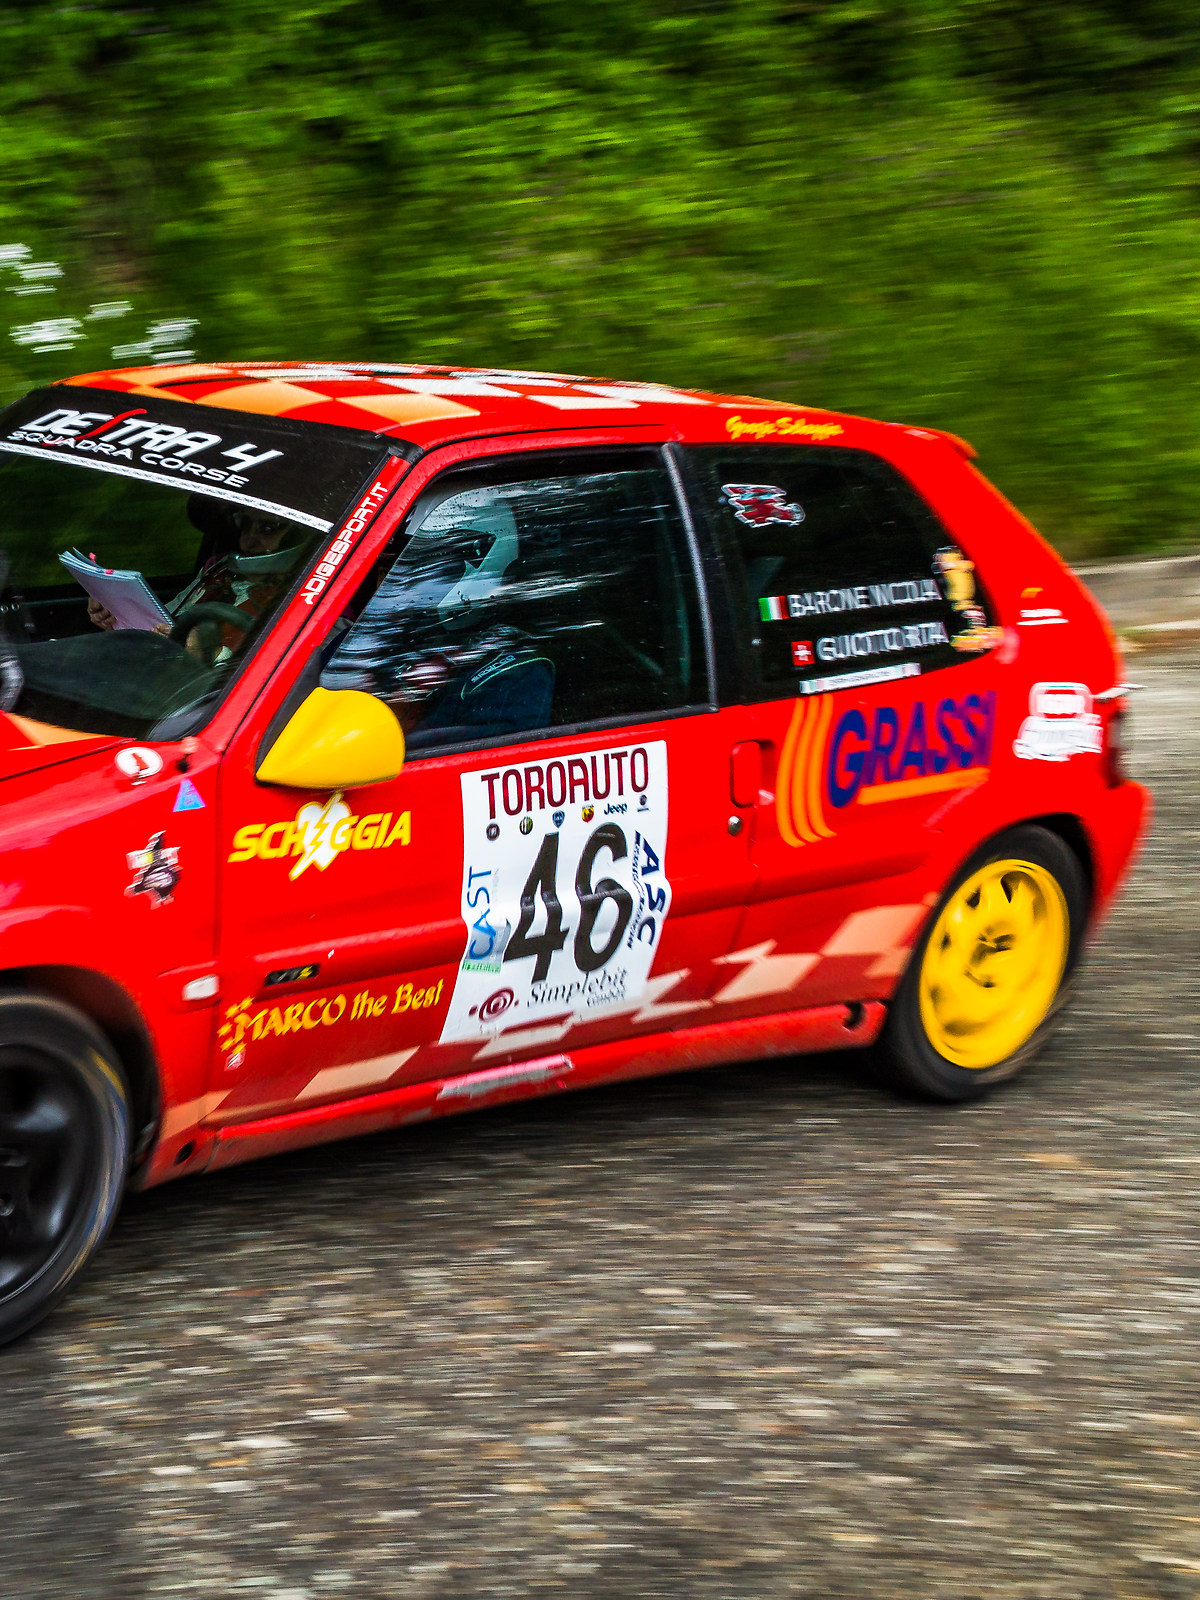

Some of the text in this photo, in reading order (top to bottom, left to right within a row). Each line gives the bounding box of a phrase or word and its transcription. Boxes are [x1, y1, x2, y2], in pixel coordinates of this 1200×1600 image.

[6, 430, 250, 488] SQUADRA CORSE
[220, 442, 285, 473] 4
[299, 482, 385, 605] ADIGESPORT.IT
[786, 585, 871, 618] BARONE
[901, 621, 950, 649] RITA
[481, 747, 649, 820] TOROAUTO
[826, 690, 998, 809] GRASSI
[603, 802, 628, 816] Jeep
[466, 865, 497, 960] CAST
[502, 821, 634, 984] 46
[634, 829, 667, 947] ASC
[232, 978, 445, 1043] MARCO the Best
